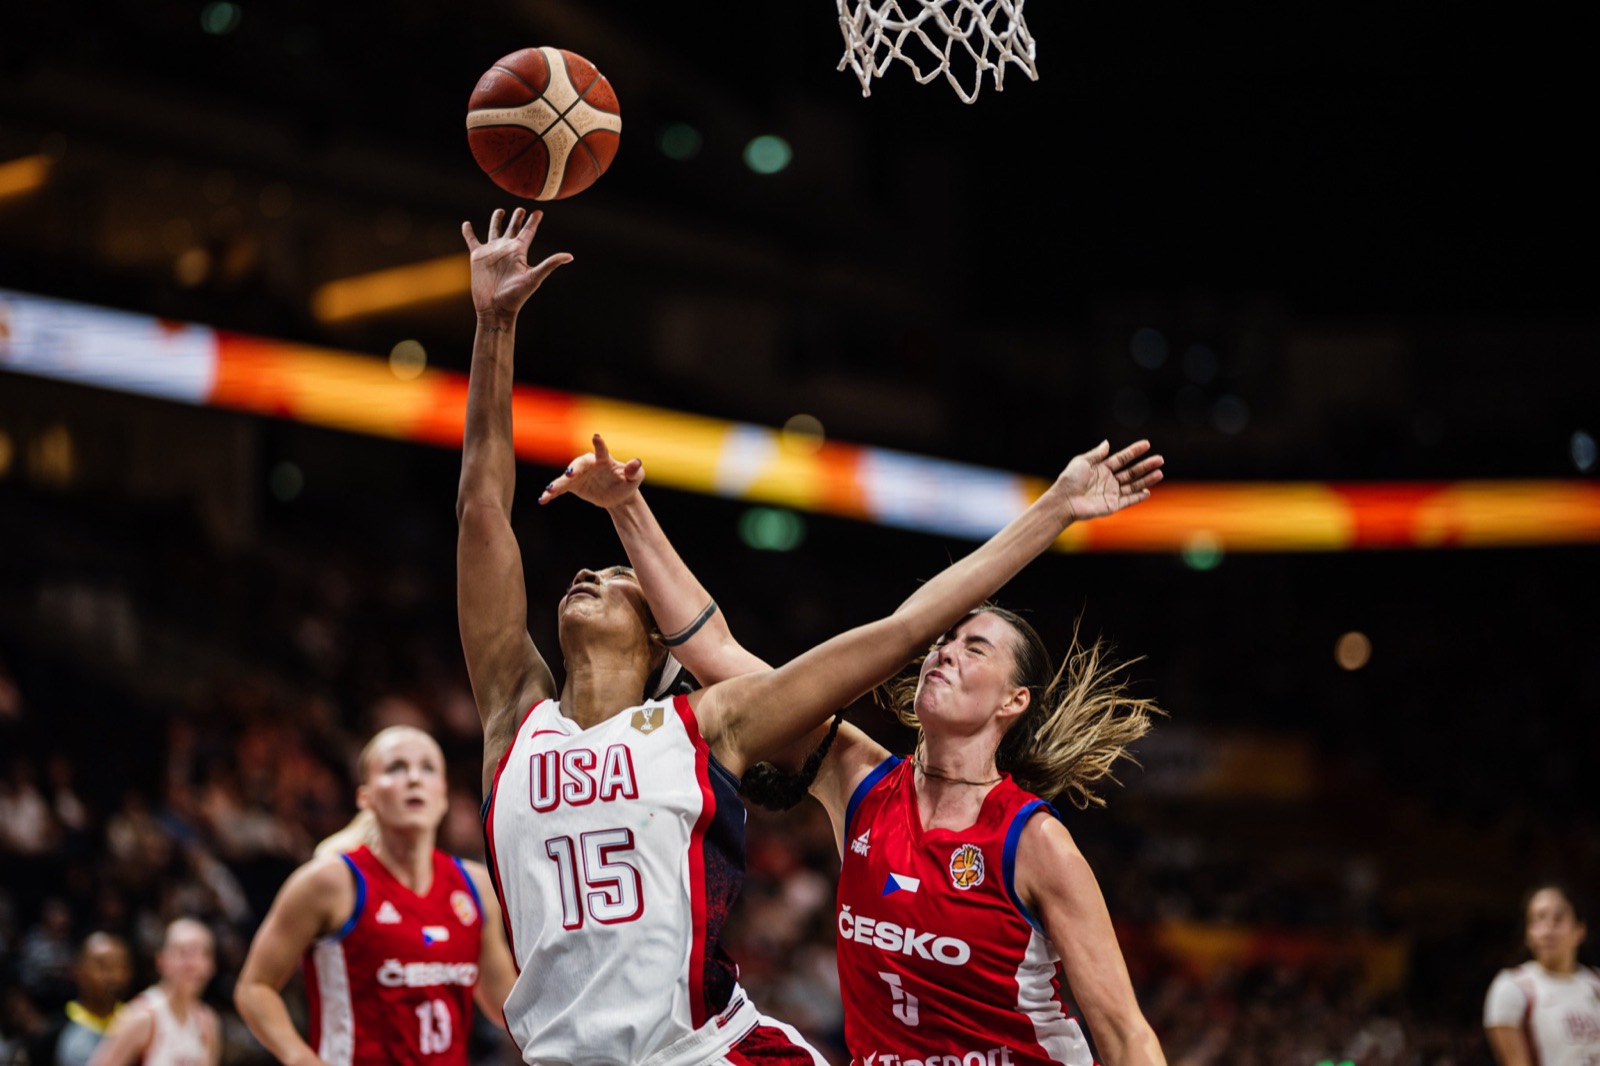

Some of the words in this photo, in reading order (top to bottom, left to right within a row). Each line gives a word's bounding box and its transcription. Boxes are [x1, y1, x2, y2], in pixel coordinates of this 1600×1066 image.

[530, 743, 640, 812] USA
[545, 827, 644, 930] 15
[838, 904, 971, 966] ČESKO
[415, 999, 452, 1055] 13
